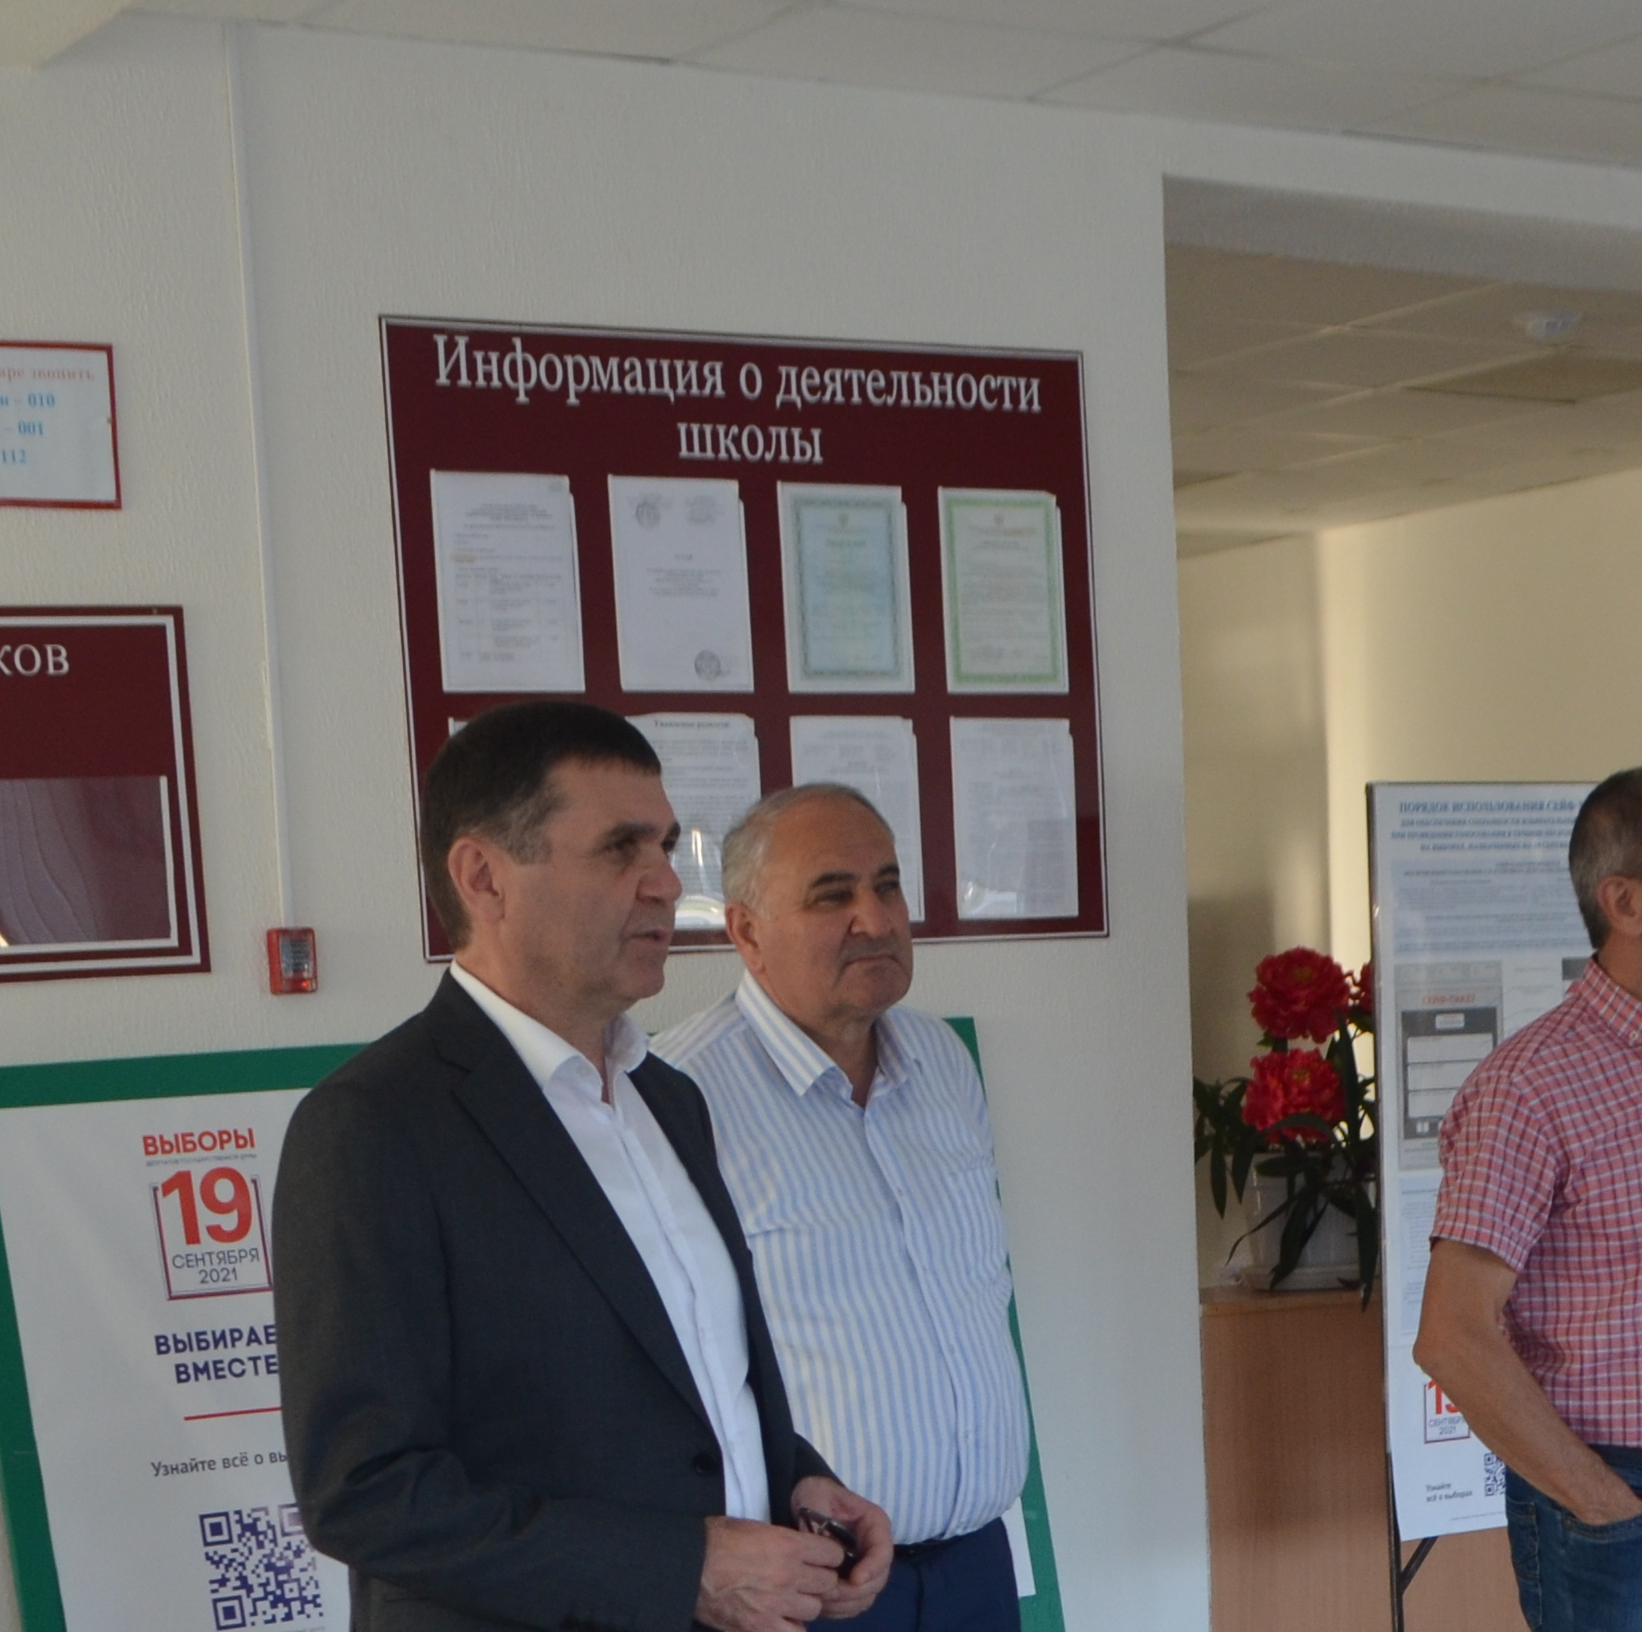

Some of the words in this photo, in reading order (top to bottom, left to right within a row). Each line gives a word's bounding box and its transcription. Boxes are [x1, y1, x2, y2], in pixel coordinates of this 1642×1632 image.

[433, 332, 725, 405] Информация
[738, 361, 763, 400] о
[775, 363, 1044, 413] деятельности
[27, 391, 56, 407] 010
[17, 421, 46, 436] 001
[676, 420, 824, 464] школы
[0, 449, 29, 465] 112
[142, 1128, 255, 1156] ВЫБОРЫ
[161, 1166, 253, 1245] 19
[172, 1248, 260, 1269] СЕНТЯБРЯ
[198, 1268, 238, 1284] 2021
[154, 1324, 277, 1355] ВЫБИРАЕ
[174, 1354, 279, 1384] ВМЕСТЕ
[151, 1457, 216, 1477] Узнайте
[221, 1452, 249, 1469] всё
[254, 1453, 264, 1465] о
